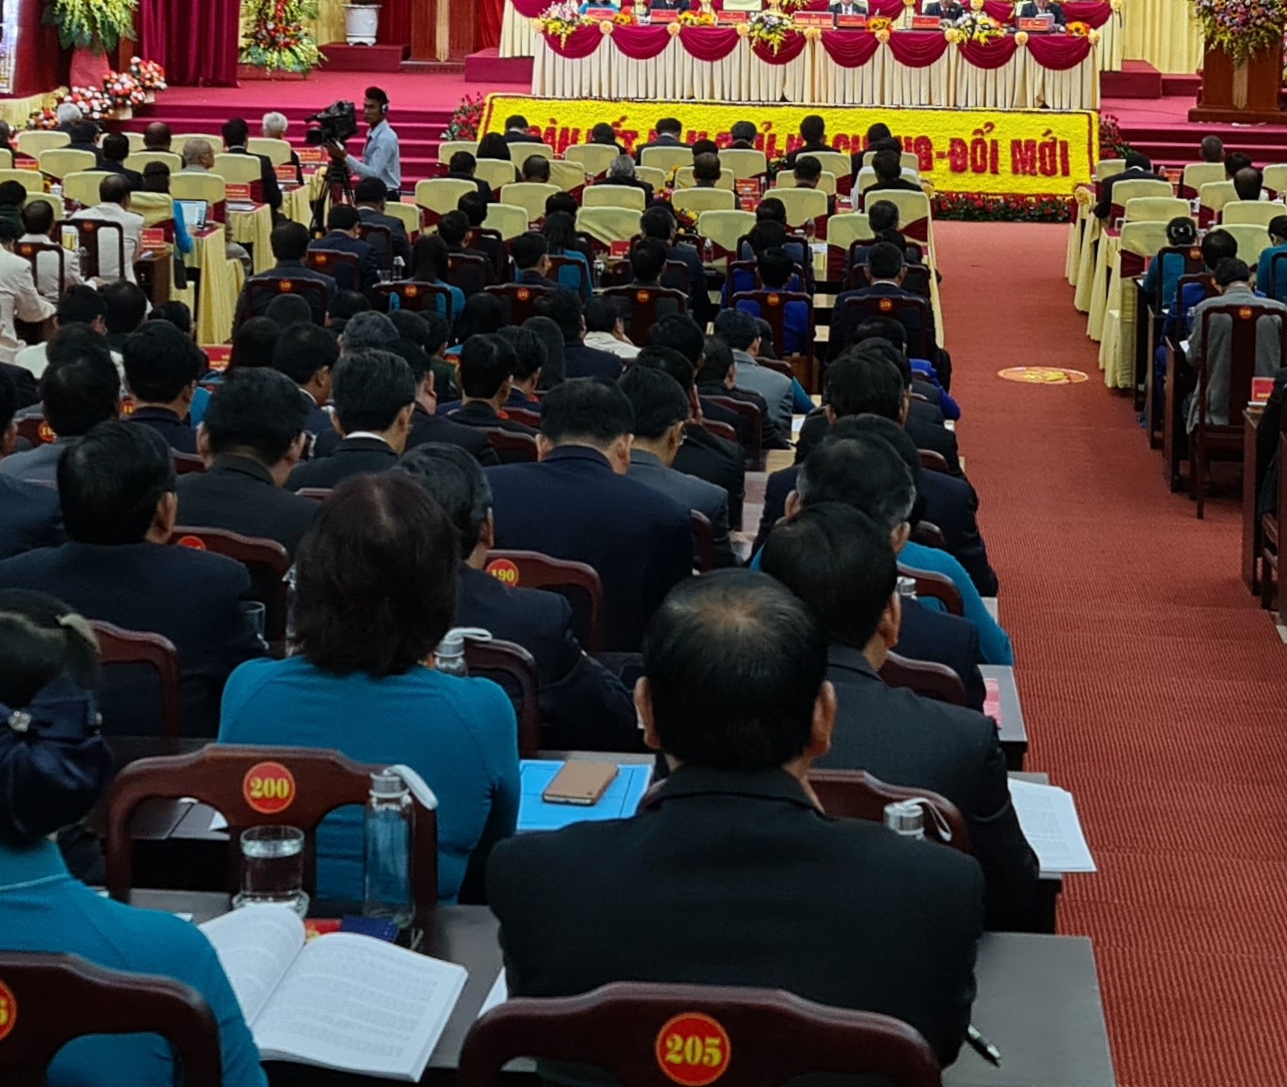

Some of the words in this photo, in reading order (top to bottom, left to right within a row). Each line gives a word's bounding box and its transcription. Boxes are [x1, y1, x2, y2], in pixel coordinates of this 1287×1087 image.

[1010, 129, 1071, 177] MỚI
[250, 776, 290, 799] 200
[666, 1035, 722, 1066] 205
